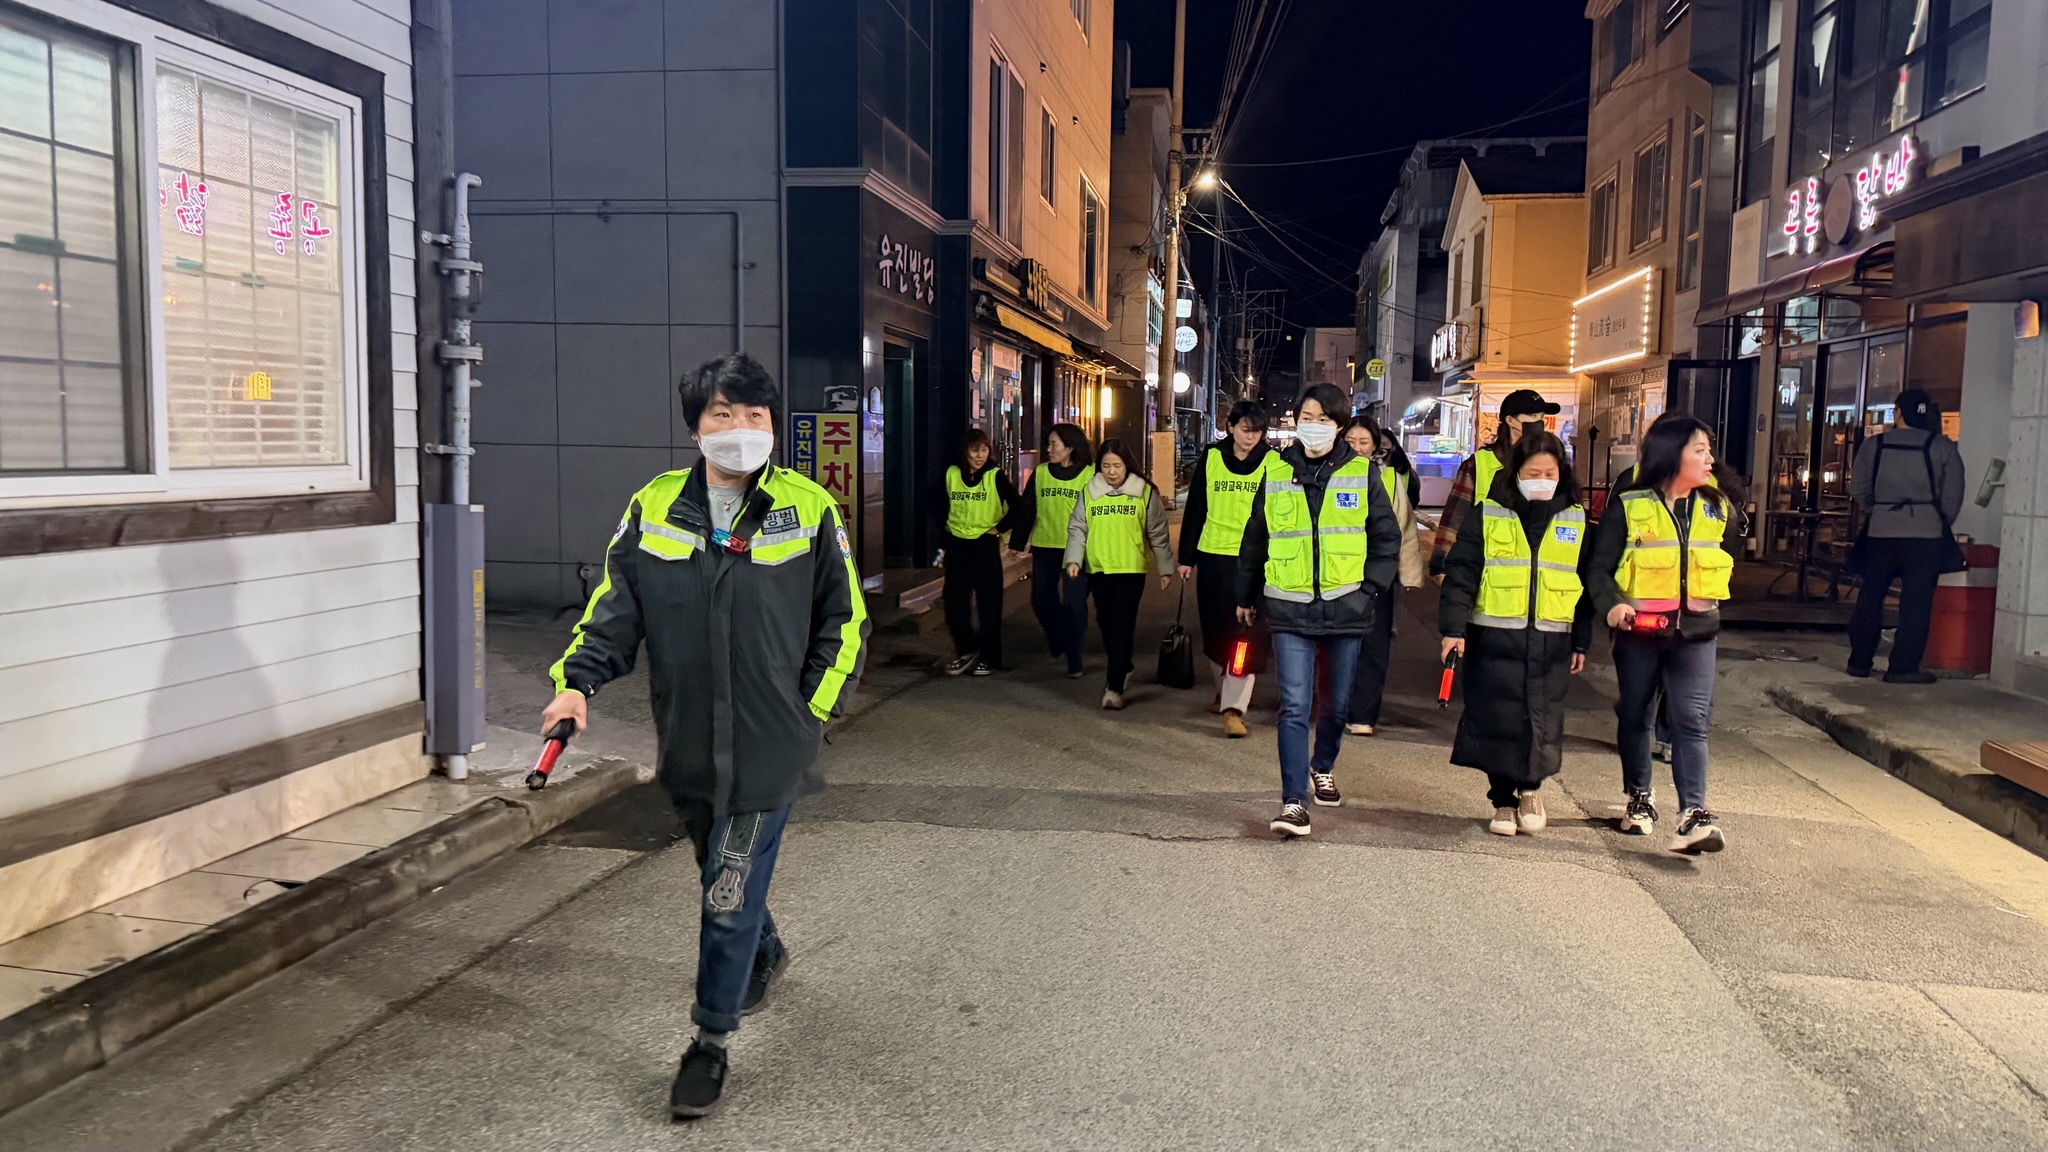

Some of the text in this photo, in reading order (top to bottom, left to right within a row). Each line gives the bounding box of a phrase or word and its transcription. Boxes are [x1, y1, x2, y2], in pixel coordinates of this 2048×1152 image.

[1784, 177, 1819, 256] 공룡
[878, 233, 935, 306] 유진빌딩
[1213, 480, 1261, 493] 밀양교육지원
[765, 509, 793, 527] 방범
[1090, 504, 1136, 517] 밀양교육지원청
